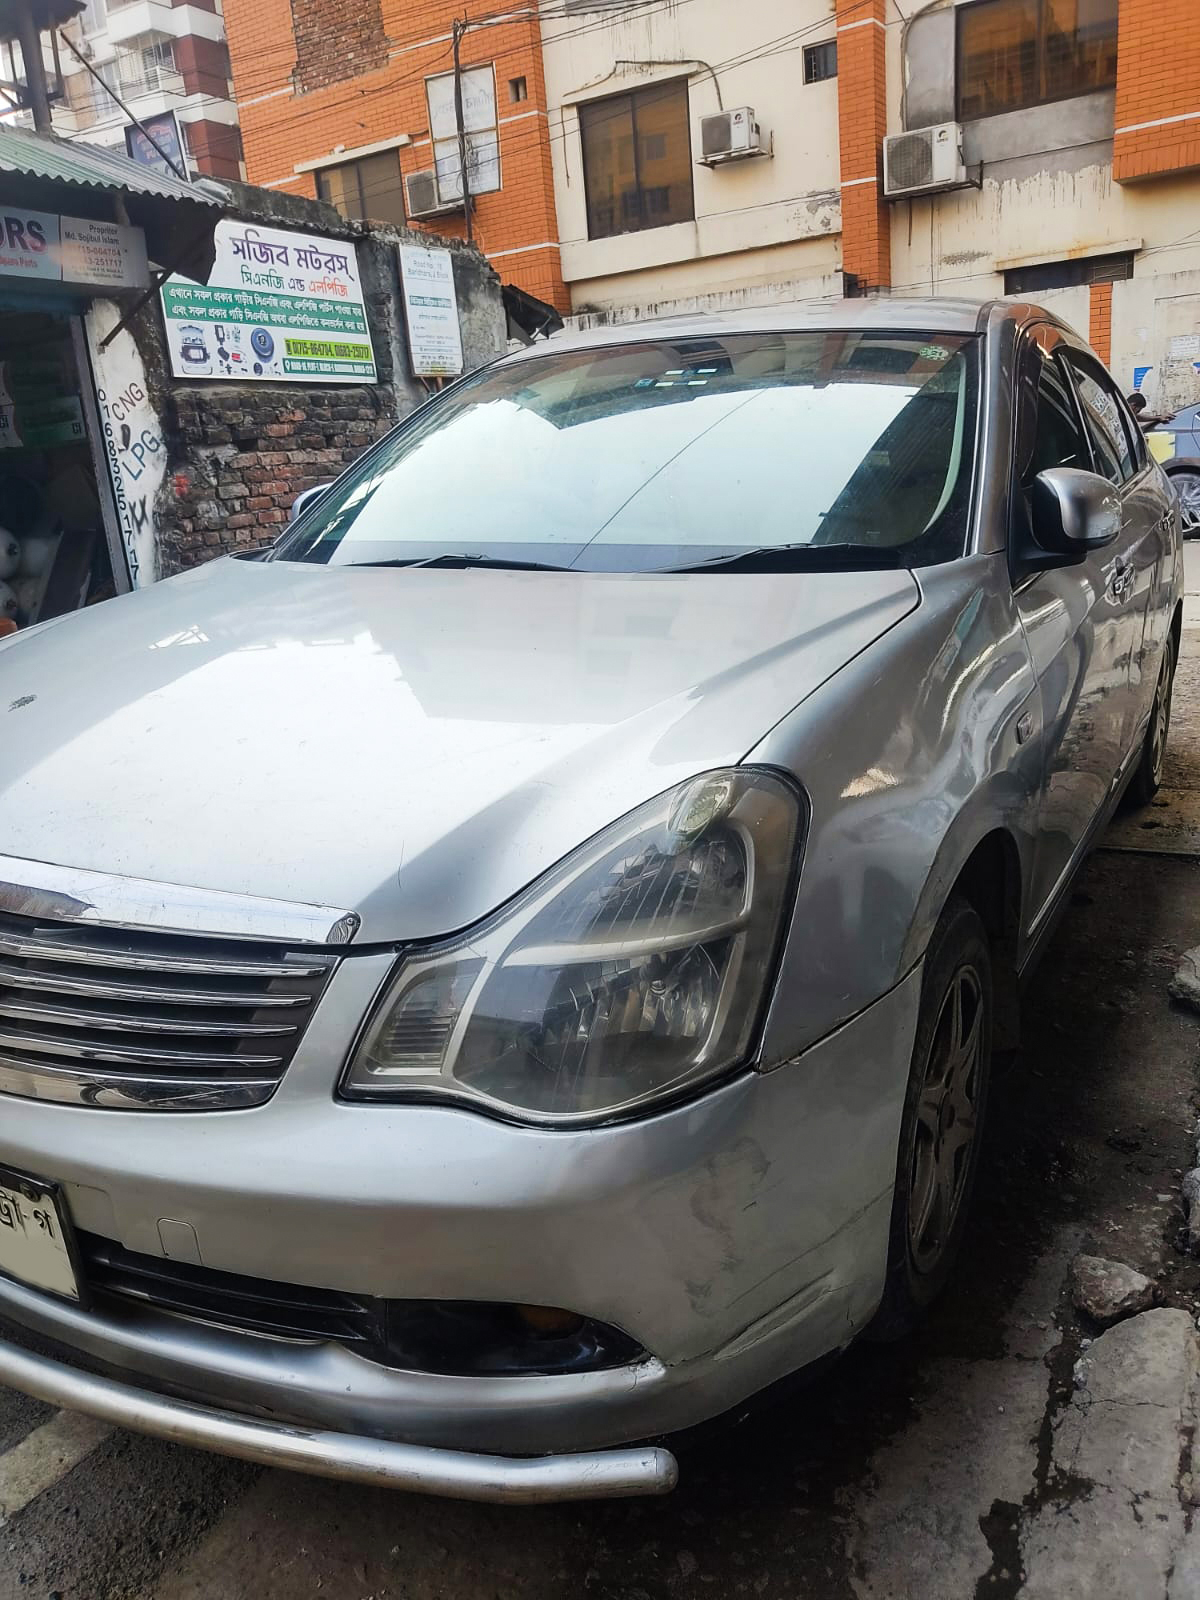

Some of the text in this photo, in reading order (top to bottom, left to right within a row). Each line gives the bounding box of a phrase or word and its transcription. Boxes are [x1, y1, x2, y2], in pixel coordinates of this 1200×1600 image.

[0, 216, 47, 256] RS
[229, 228, 289, 267] সজিব
[169, 288, 193, 300] এখানে
[193, 290, 212, 301] সকল
[213, 292, 233, 303] প্রকার
[241, 264, 349, 298] সিএনজি এন্ড এলপিজি
[172, 305, 188, 317] এবং
[188, 306, 207, 317] সকল
[208, 308, 227, 319] প্রকার
[111, 382, 145, 421] CNG
[122, 429, 162, 481] LPG
